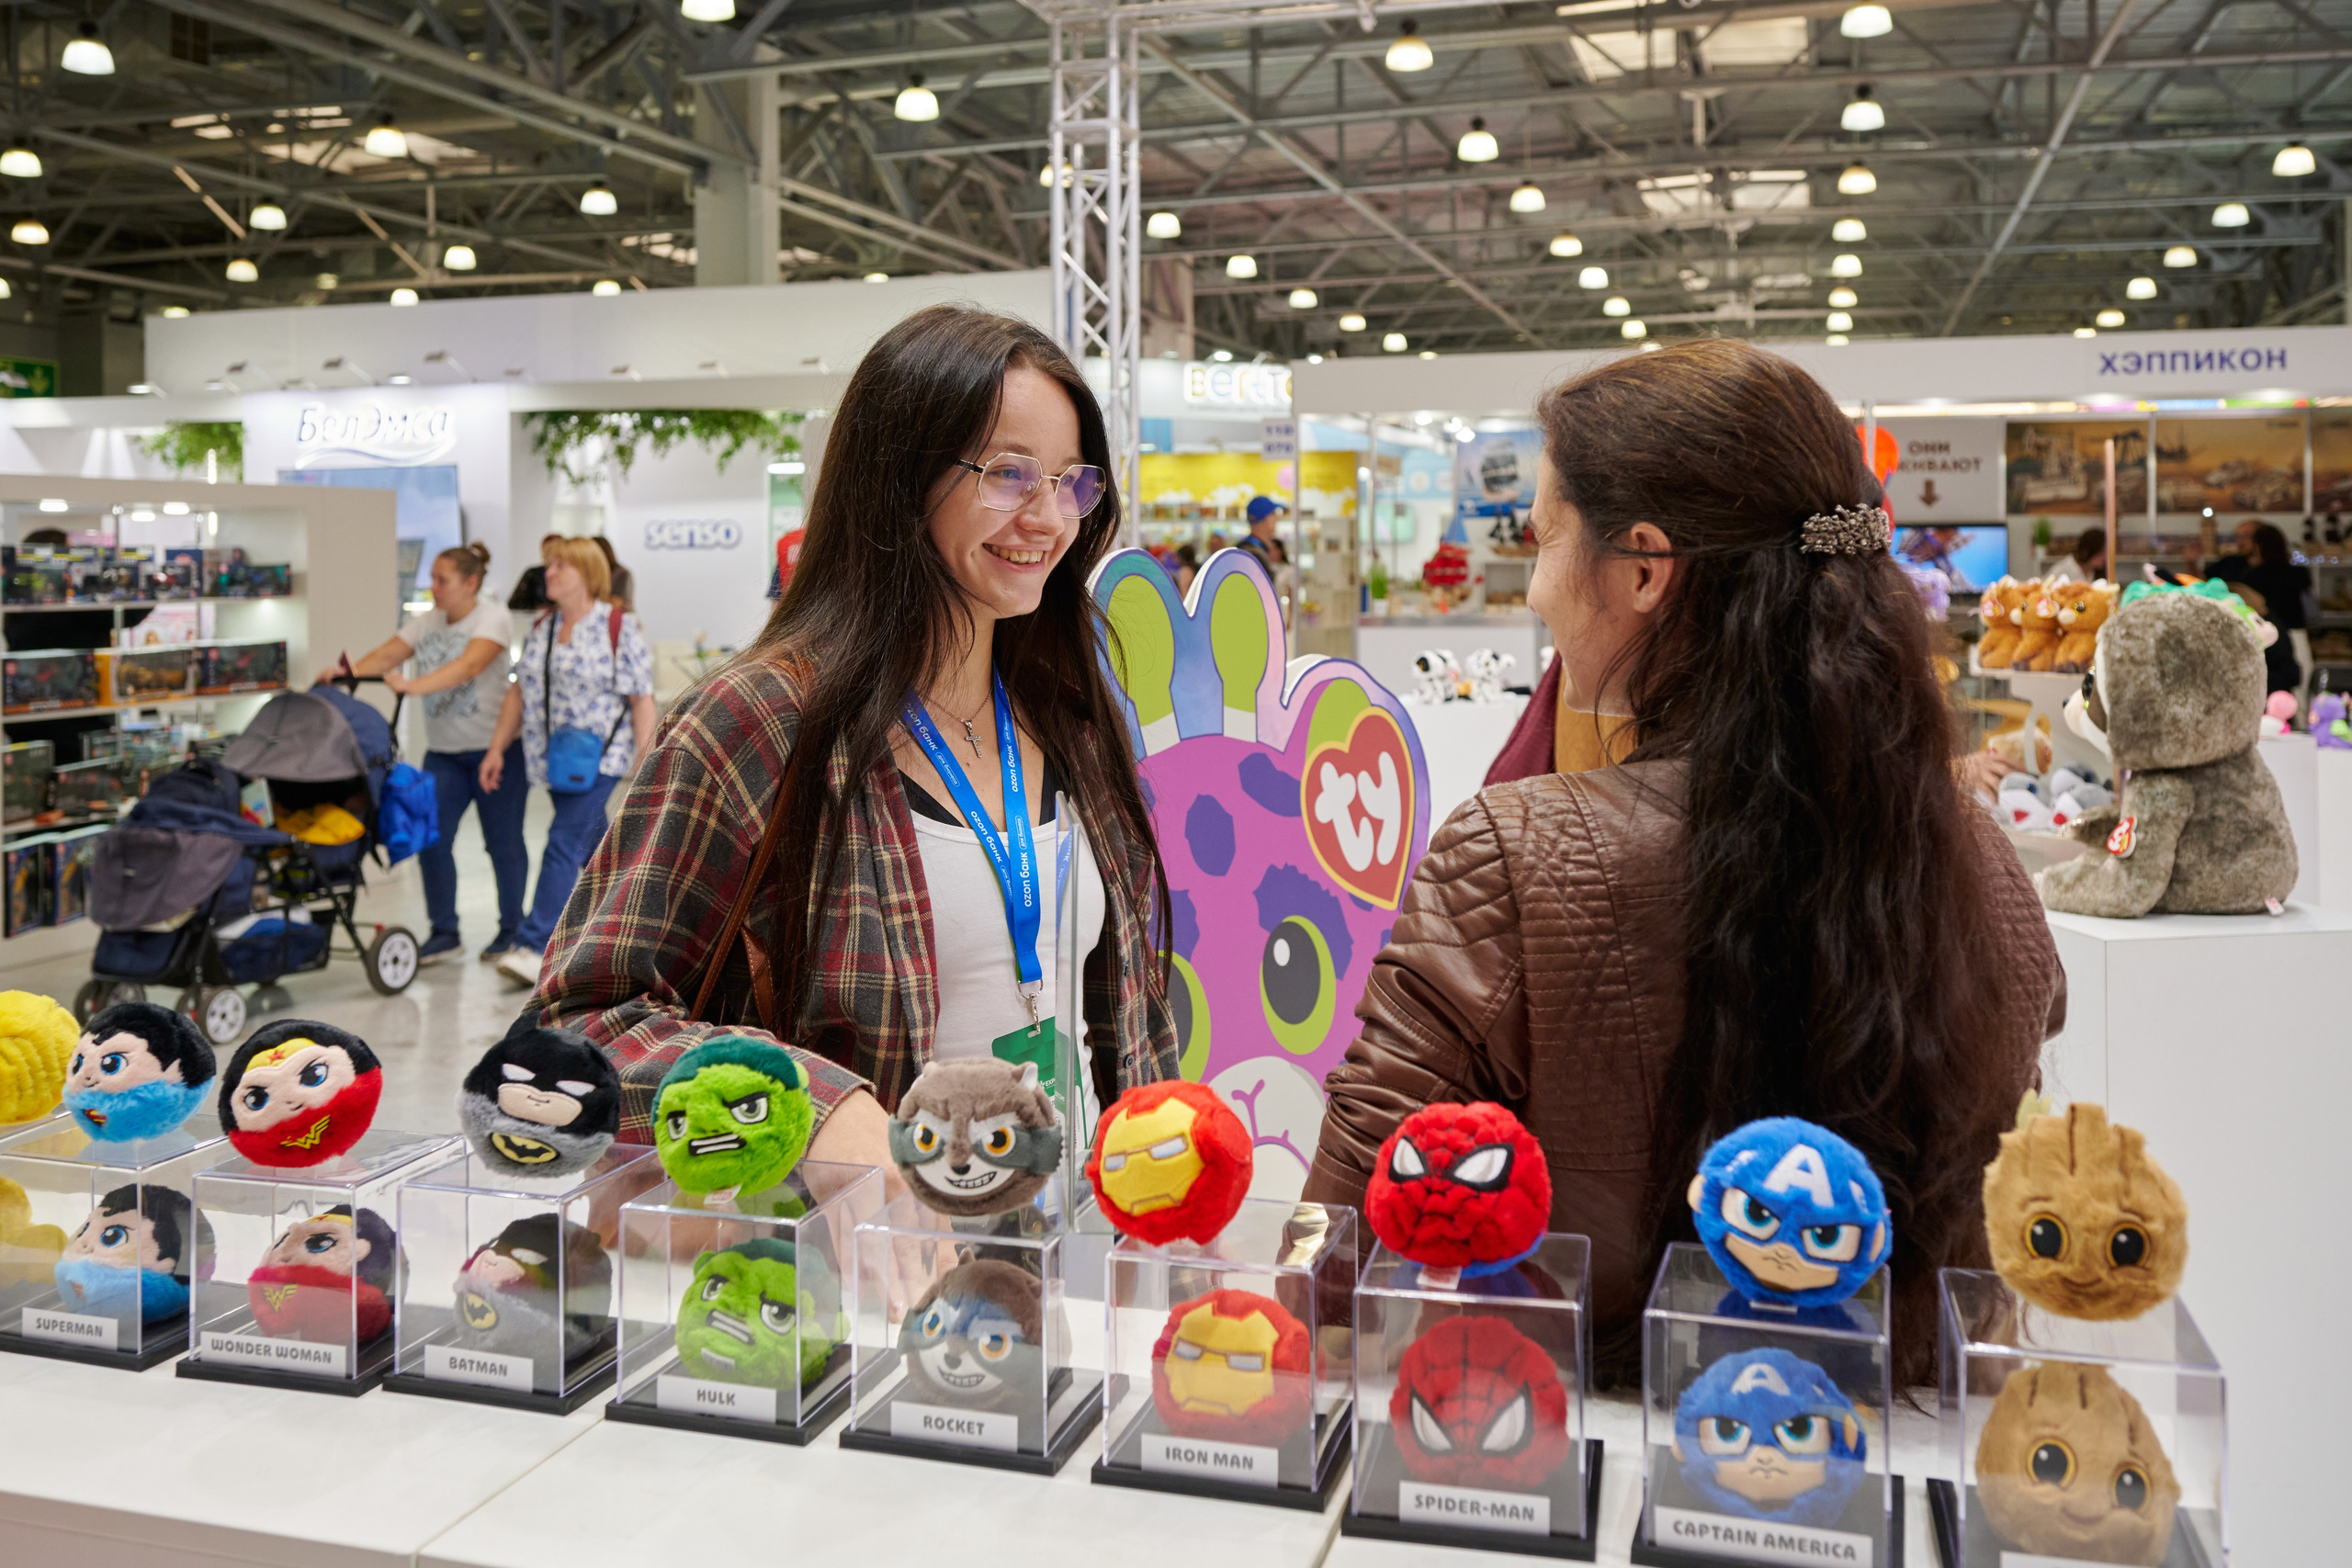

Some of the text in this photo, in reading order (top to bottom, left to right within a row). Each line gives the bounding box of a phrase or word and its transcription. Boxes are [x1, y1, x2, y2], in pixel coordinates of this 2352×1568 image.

[2098, 347, 2288, 376] ХЭППИКОН
[1898, 458, 1982, 474] ЖИВАЮТ
[646, 522, 741, 548] senso
[919, 727, 938, 751] банк
[1007, 745, 1019, 792] ozon банк
[1315, 750, 1402, 872] ty
[970, 810, 1003, 863] ozon банк
[1019, 852, 1033, 908] ozon банк
[35, 1316, 104, 1338] SUPERMAN
[210, 1338, 333, 1364] WONDER WOMAN
[447, 1357, 510, 1377] BATMAN
[695, 1387, 737, 1406] HULK
[922, 1415, 986, 1437] ROCKET
[1165, 1445, 1254, 1471] IRON MAN
[1414, 1494, 1535, 1522] SPIDER-MAN
[1672, 1519, 1858, 1561] CAPTAIN AMERICA
